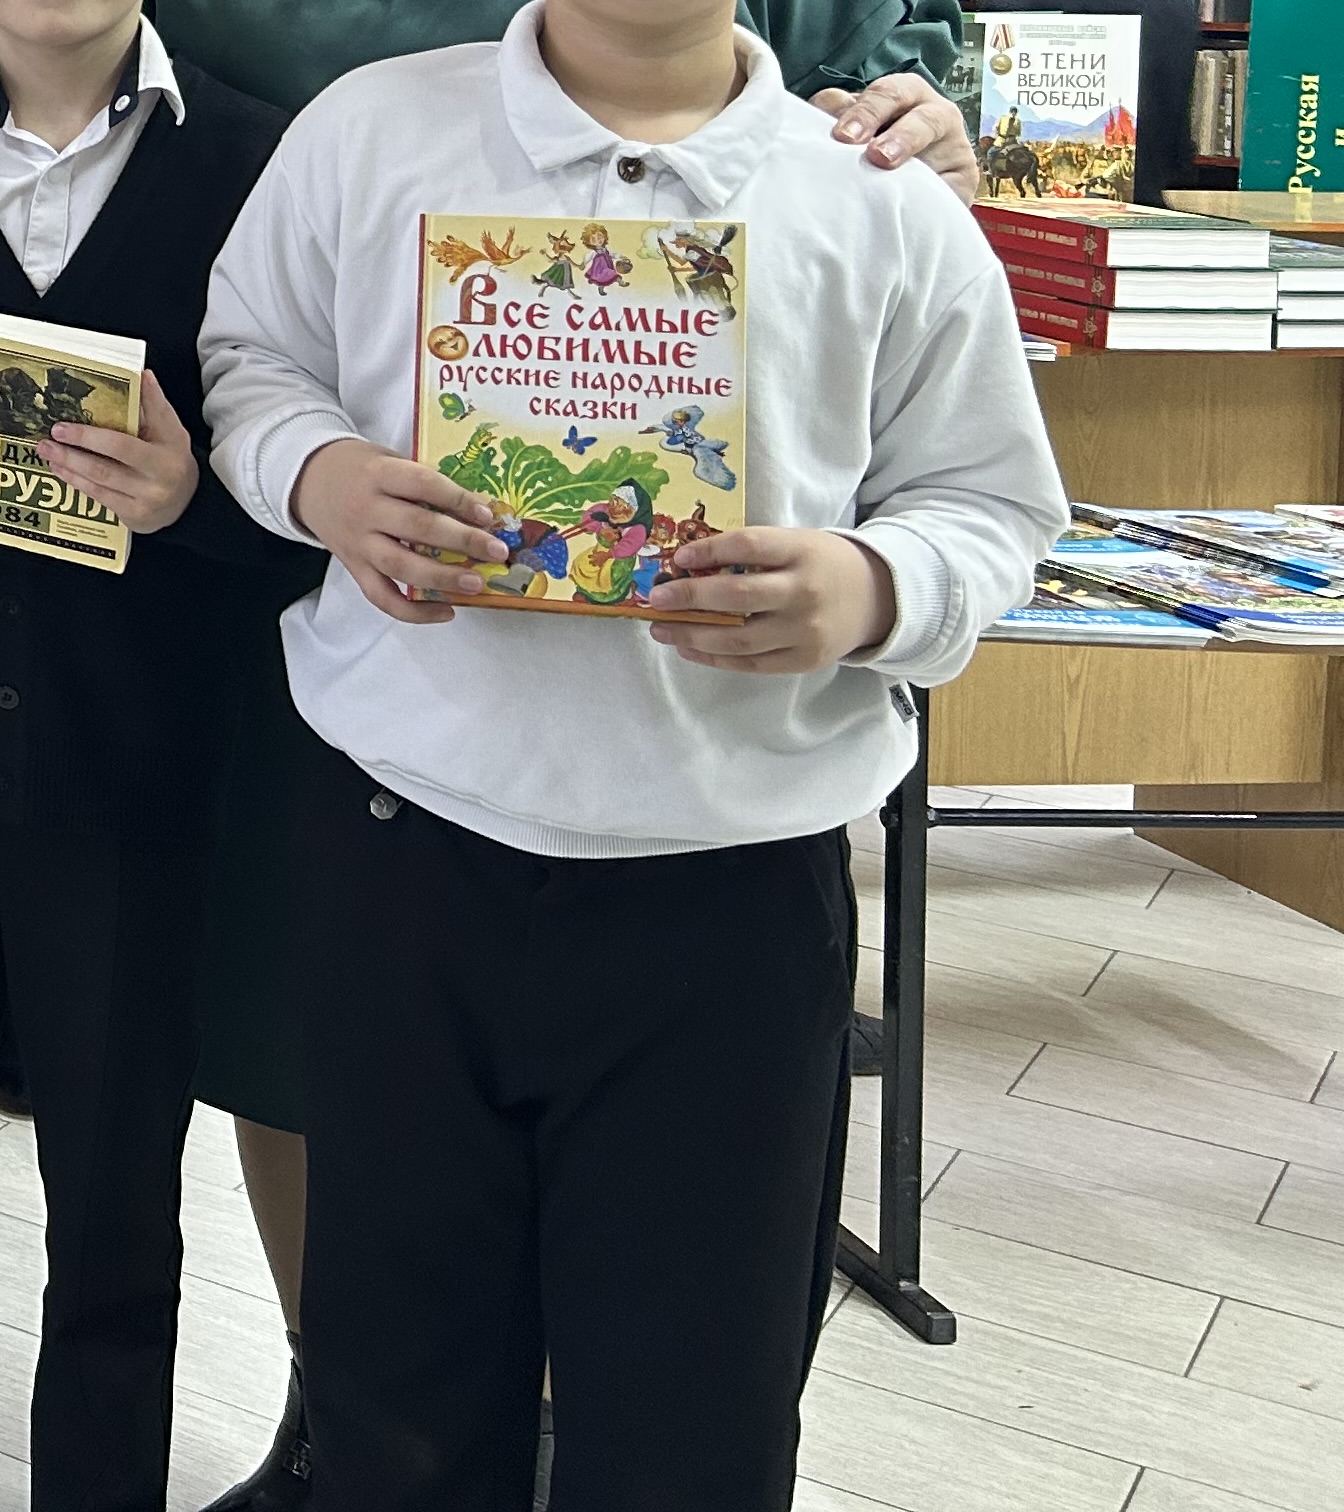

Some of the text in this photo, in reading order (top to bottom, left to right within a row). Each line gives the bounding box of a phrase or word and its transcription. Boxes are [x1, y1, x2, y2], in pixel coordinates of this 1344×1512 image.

[1018, 52, 1107, 71] В ТЕНИ
[1017, 71, 1106, 89] ВЕЛИКОЙ
[1016, 90, 1105, 110] ПОБЕДЫ
[1288, 73, 1321, 194] Русская
